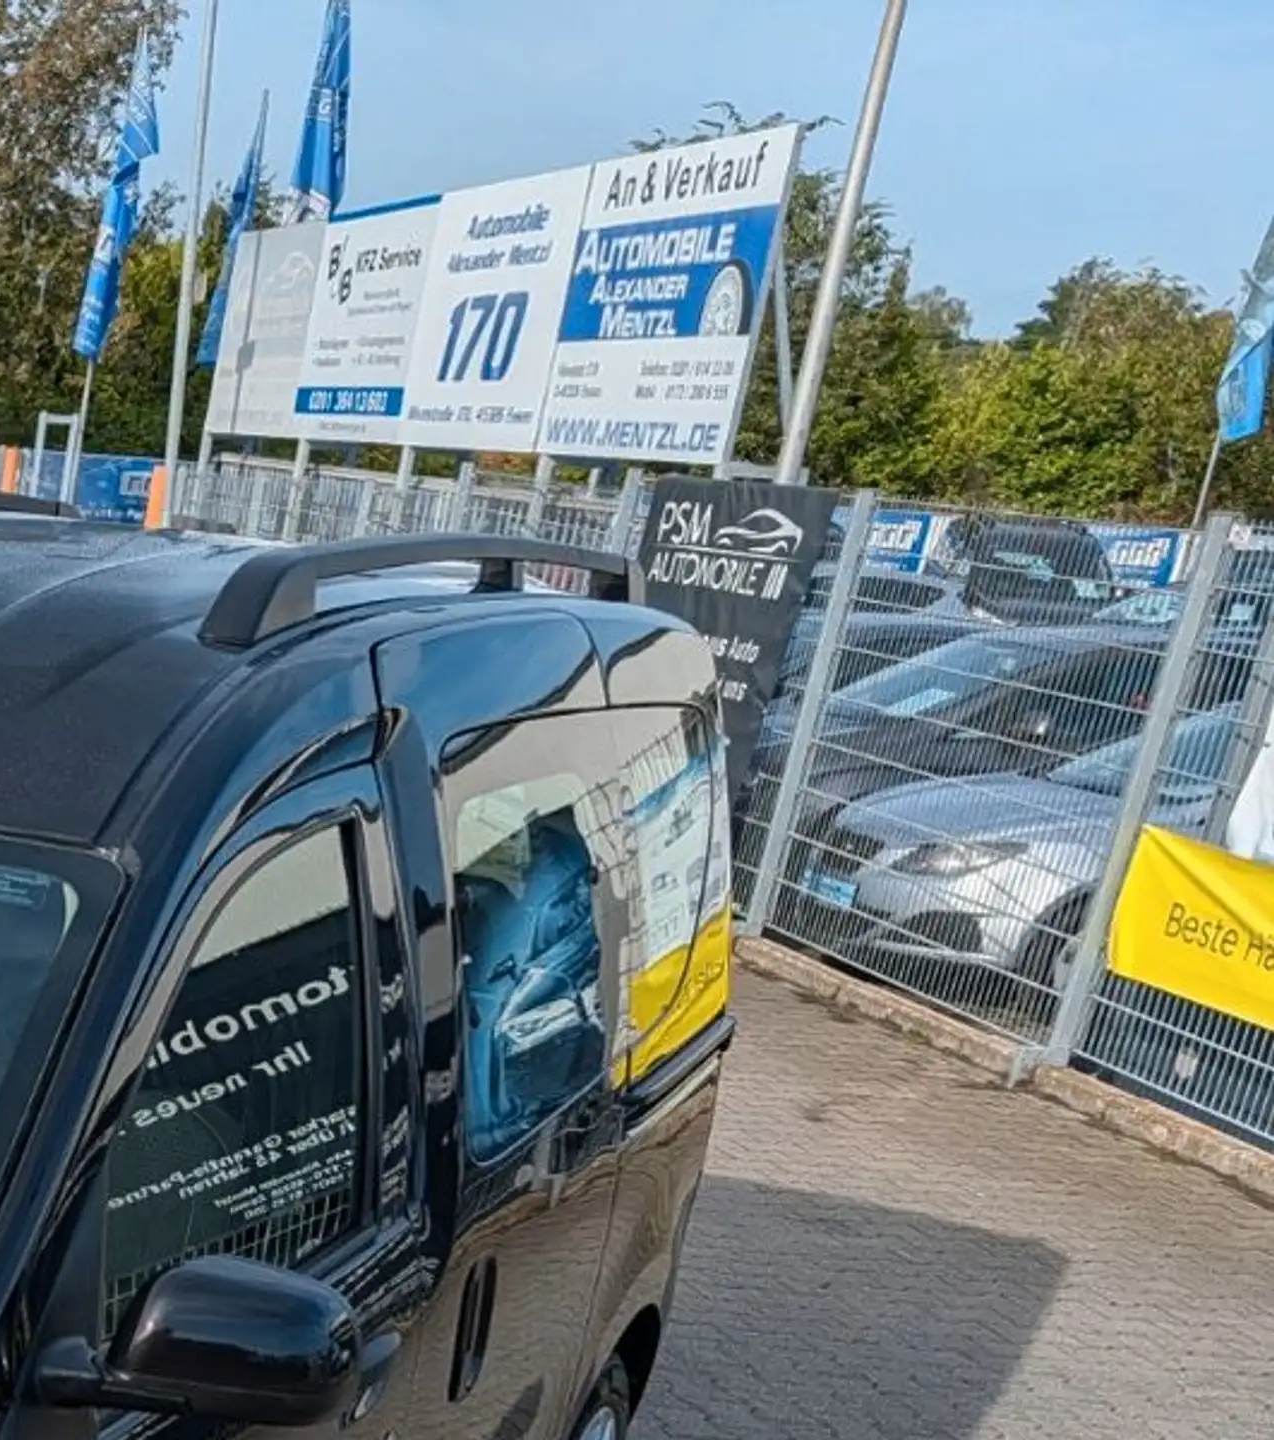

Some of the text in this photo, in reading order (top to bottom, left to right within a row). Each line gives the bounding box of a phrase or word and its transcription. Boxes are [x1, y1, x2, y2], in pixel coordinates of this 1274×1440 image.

[604, 140, 769, 210] An & Verkauf
[466, 204, 551, 242] Automobile
[355, 245, 422, 274] KFZ Service
[574, 223, 737, 275] AUTOMOBILE
[588, 273, 690, 304] ALEXANDER
[436, 291, 530, 383] 170
[599, 302, 677, 338] MENTZL
[547, 417, 720, 452] WWW.MENTZL.DE
[657, 500, 714, 545] PSM
[1164, 902, 1239, 957] Beste
